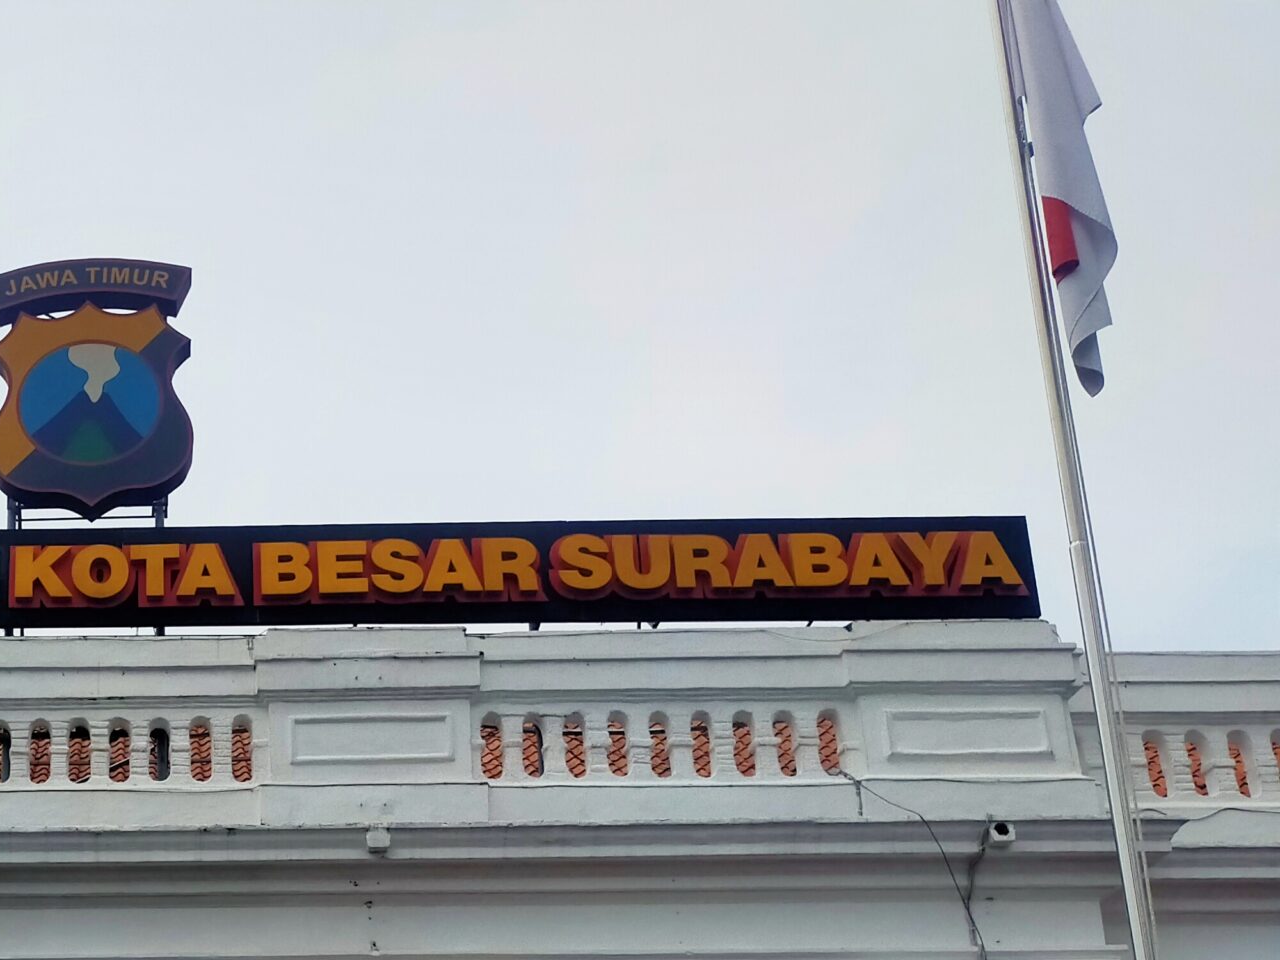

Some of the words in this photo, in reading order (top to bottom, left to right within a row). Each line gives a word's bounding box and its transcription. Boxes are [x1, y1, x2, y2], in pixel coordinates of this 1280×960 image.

[5, 268, 78, 296] JAWA
[85, 266, 170, 289] TIMUR
[11, 542, 239, 604] KOTA
[255, 537, 541, 600] BESAR
[552, 530, 1025, 595] SURABAYA
